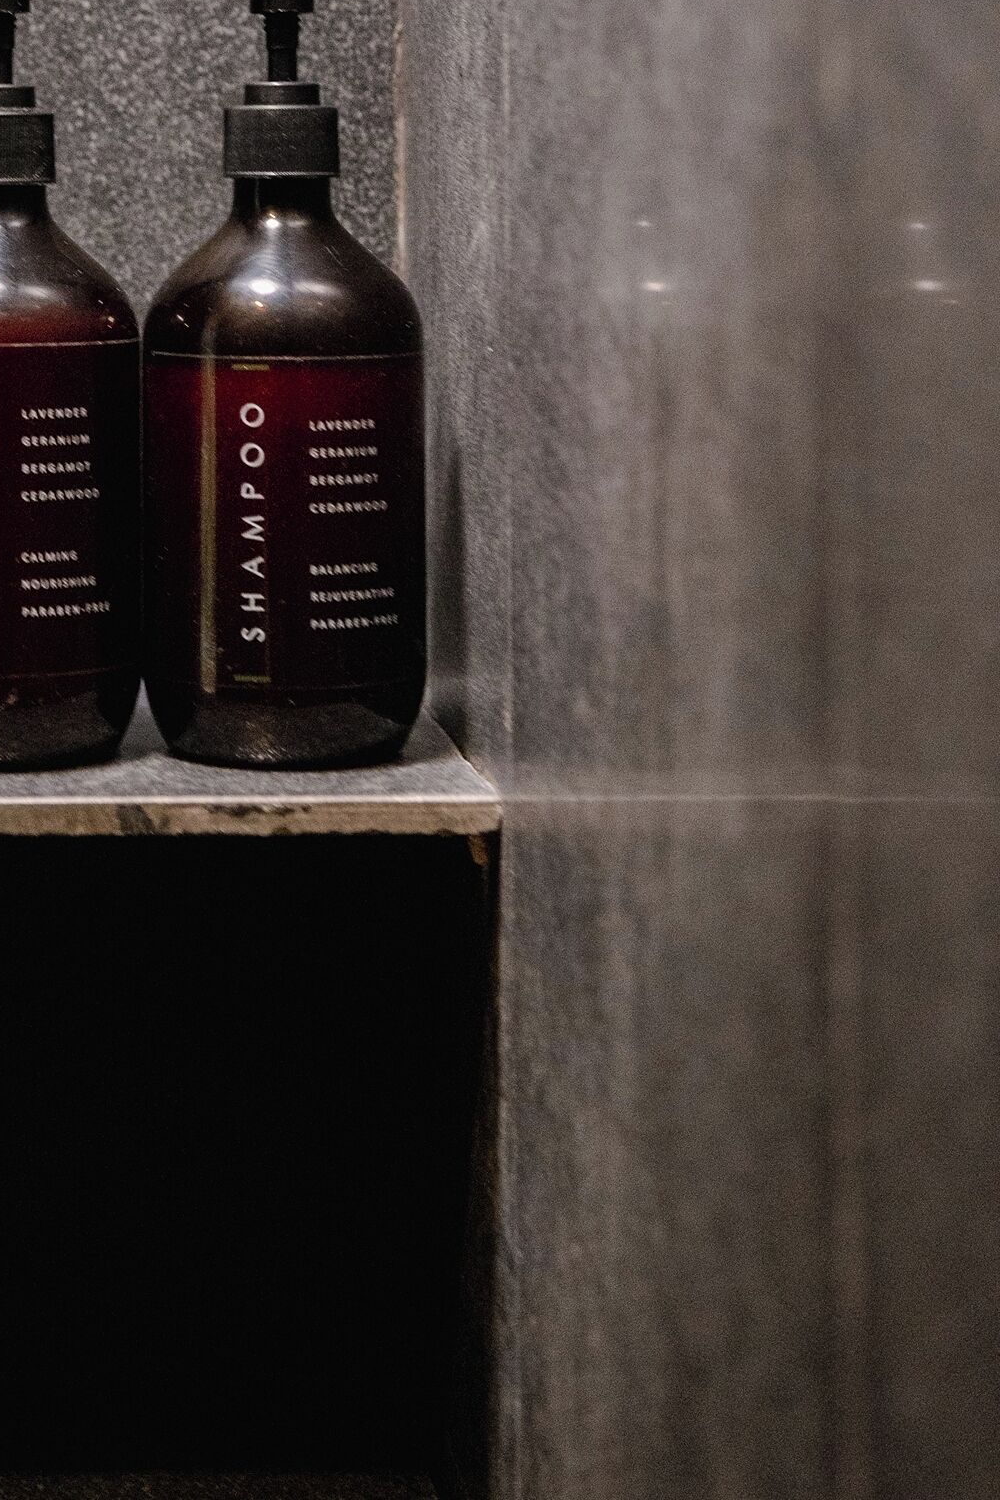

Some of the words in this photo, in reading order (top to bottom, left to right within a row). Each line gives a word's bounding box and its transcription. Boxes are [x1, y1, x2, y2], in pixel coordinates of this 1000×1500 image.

[21, 407, 88, 420] LAVENDER
[309, 419, 375, 431] LAVENDER
[21, 434, 90, 447] GERANIUM
[309, 446, 377, 459] GERANIUM
[21, 461, 91, 474] BERGAMOT
[309, 473, 378, 486] BERGAMOT
[21, 488, 100, 502] CEDARWOOD
[309, 500, 388, 514] CEDARWOOD
[239, 402, 266, 642] SHAMPOO
[21, 550, 78, 563] CALMING
[309, 562, 378, 576] BALANCING
[21, 575, 97, 590] NOURISHING
[310, 587, 395, 603] REJUVENATING
[21, 601, 110, 617] PARABEN-FREE
[310, 614, 399, 630] PARABEN-FREE
